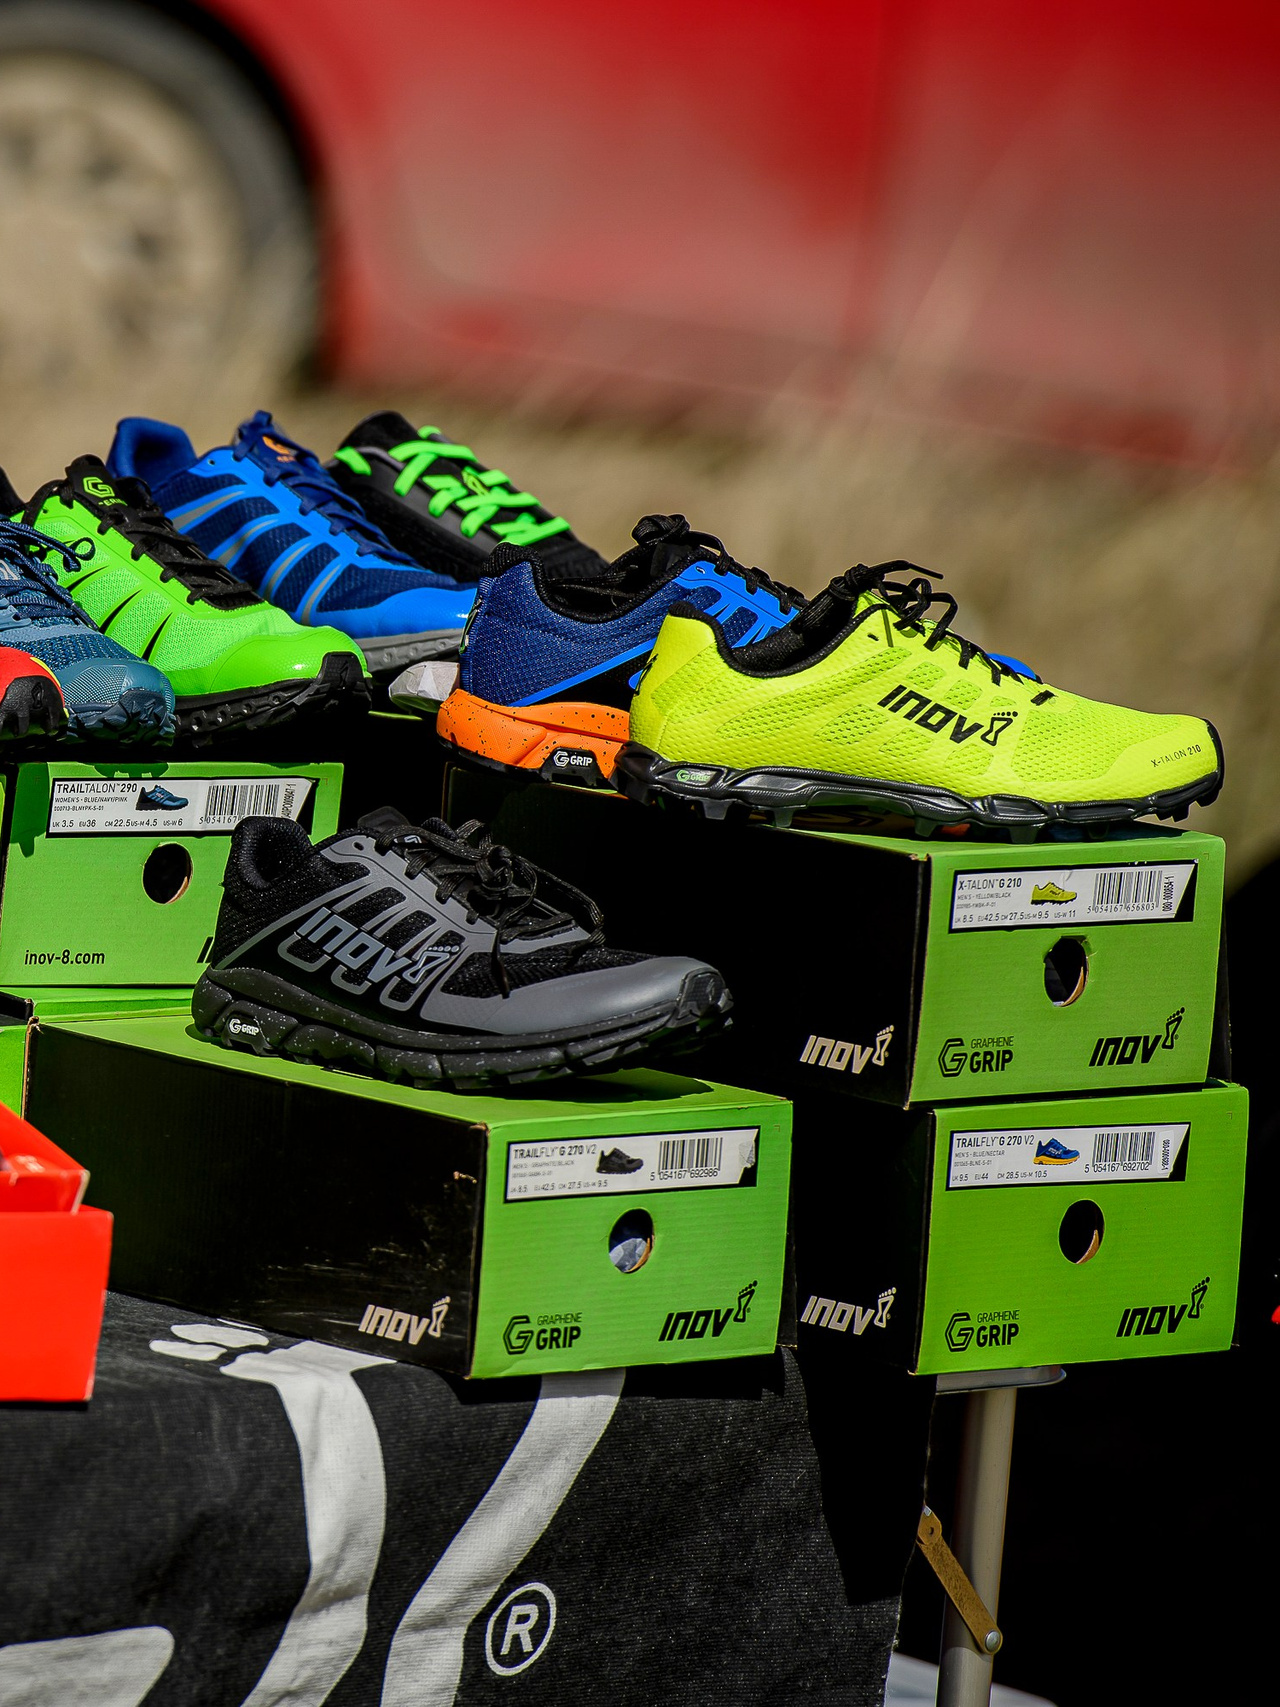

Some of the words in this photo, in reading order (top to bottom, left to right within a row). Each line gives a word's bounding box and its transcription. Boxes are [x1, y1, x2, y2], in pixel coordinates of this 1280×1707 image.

[570, 755, 593, 767] GRIP
[1150, 749, 1187, 768] X-TALON
[1187, 744, 1202, 756] 210
[120, 783, 138, 793] 290
[1007, 878, 1022, 888] 210
[1095, 904, 1123, 913] 054167
[1126, 902, 1155, 912] 656803
[25, 949, 105, 965] inov-8.com
[241, 1024, 260, 1036] GRIP
[970, 1036, 1014, 1049] GRAPHENE
[969, 1051, 1014, 1073] GRIP
[1007, 1135, 1023, 1146] 270
[1024, 1135, 1035, 1145] V2
[567, 1145, 584, 1156] 270
[586, 1144, 597, 1154] V2
[1093, 1162, 1120, 1173] 054167
[1122, 1161, 1150, 1171] 692702
[658, 1170, 687, 1181] 054167
[689, 1168, 719, 1179] 692986
[1034, 1170, 1048, 1178] 10.5
[537, 1312, 583, 1326] GRAPHENE
[977, 1310, 1020, 1323] GRAPHENE
[535, 1326, 582, 1351] GRIP
[976, 1322, 1020, 1348] GRIP
